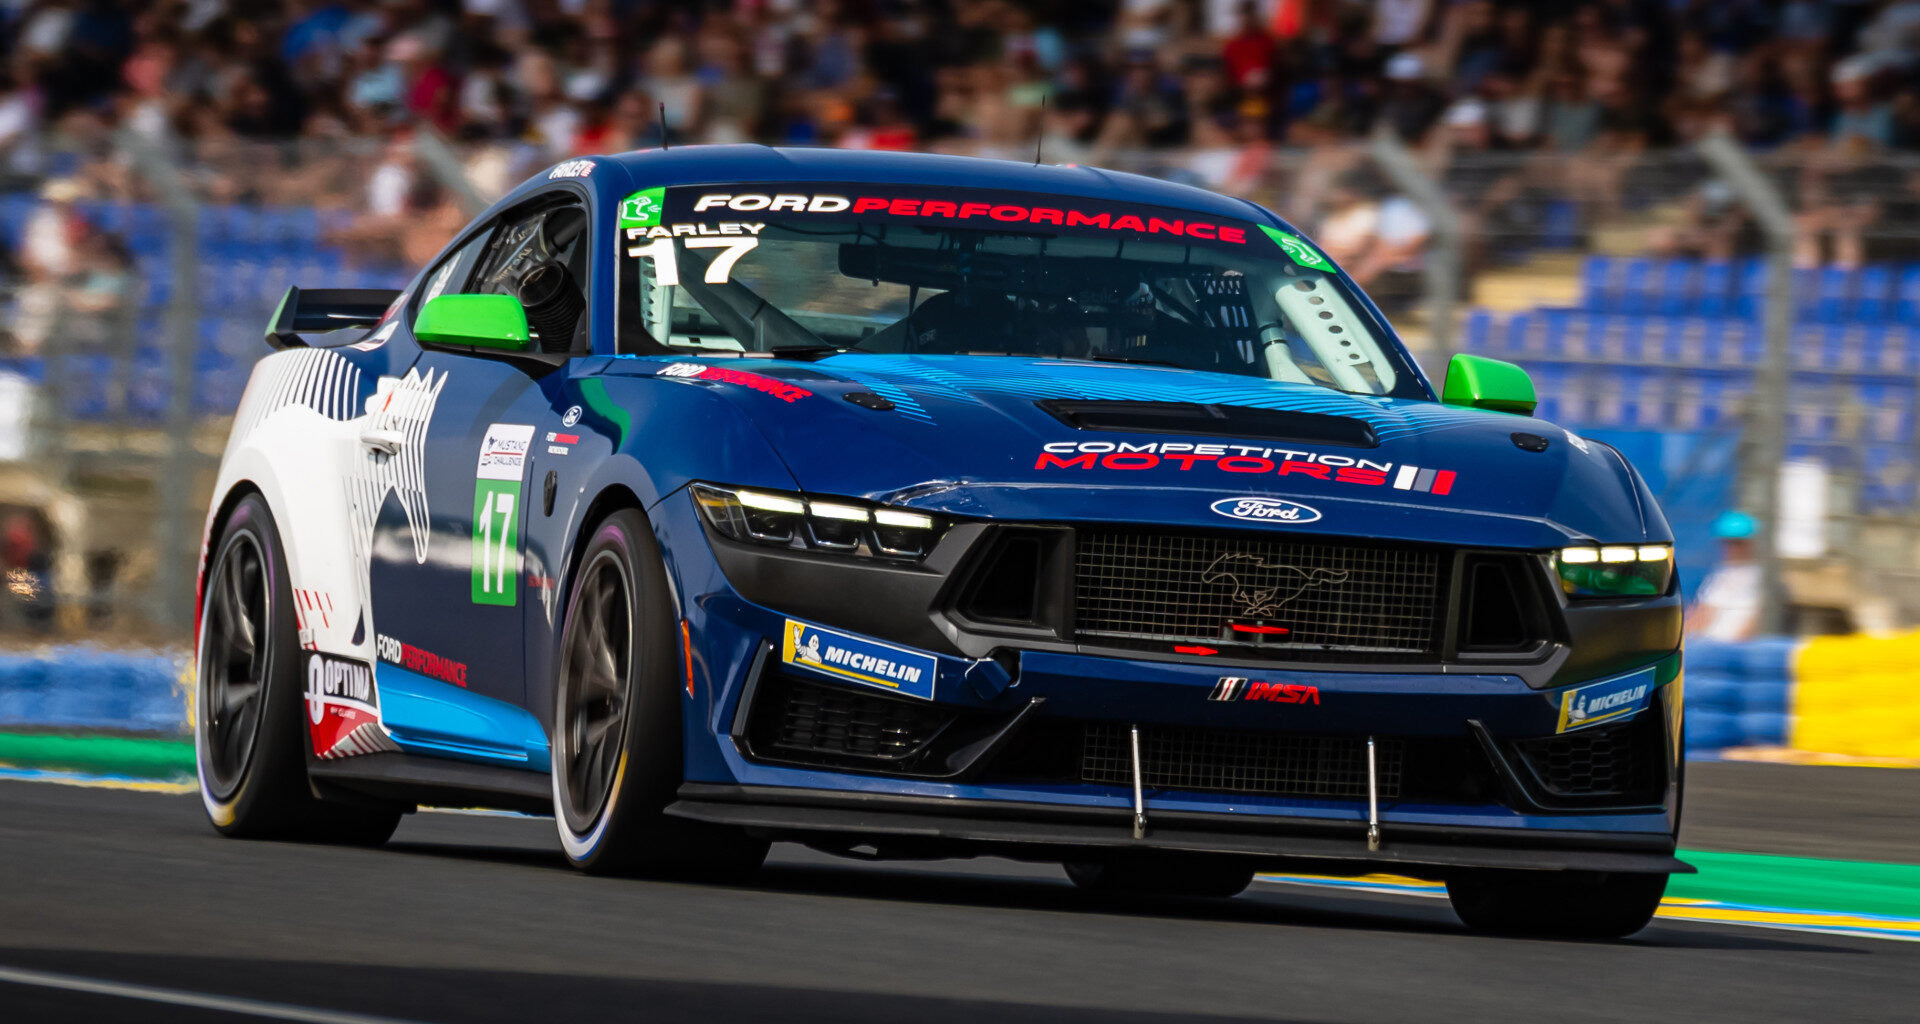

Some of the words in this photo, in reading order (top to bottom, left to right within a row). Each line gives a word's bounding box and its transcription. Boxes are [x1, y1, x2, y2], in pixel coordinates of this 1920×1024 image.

[626, 222, 766, 240] FARLEY
[693, 194, 851, 213] FORD
[852, 196, 1247, 245] PERFORMANCE
[628, 236, 759, 286] 17
[1034, 452, 1388, 486] MOTORS
[1043, 441, 1393, 472] COMPETITION
[1233, 500, 1300, 520] Ford
[479, 490, 515, 594] 17
[376, 633, 402, 664] FORD
[400, 642, 467, 688] PERFORMANCE
[824, 645, 922, 683] MICHELIN
[324, 659, 370, 702] OPTIMA
[1244, 681, 1320, 706] IMSA
[1587, 684, 1648, 714] MICHELIN
